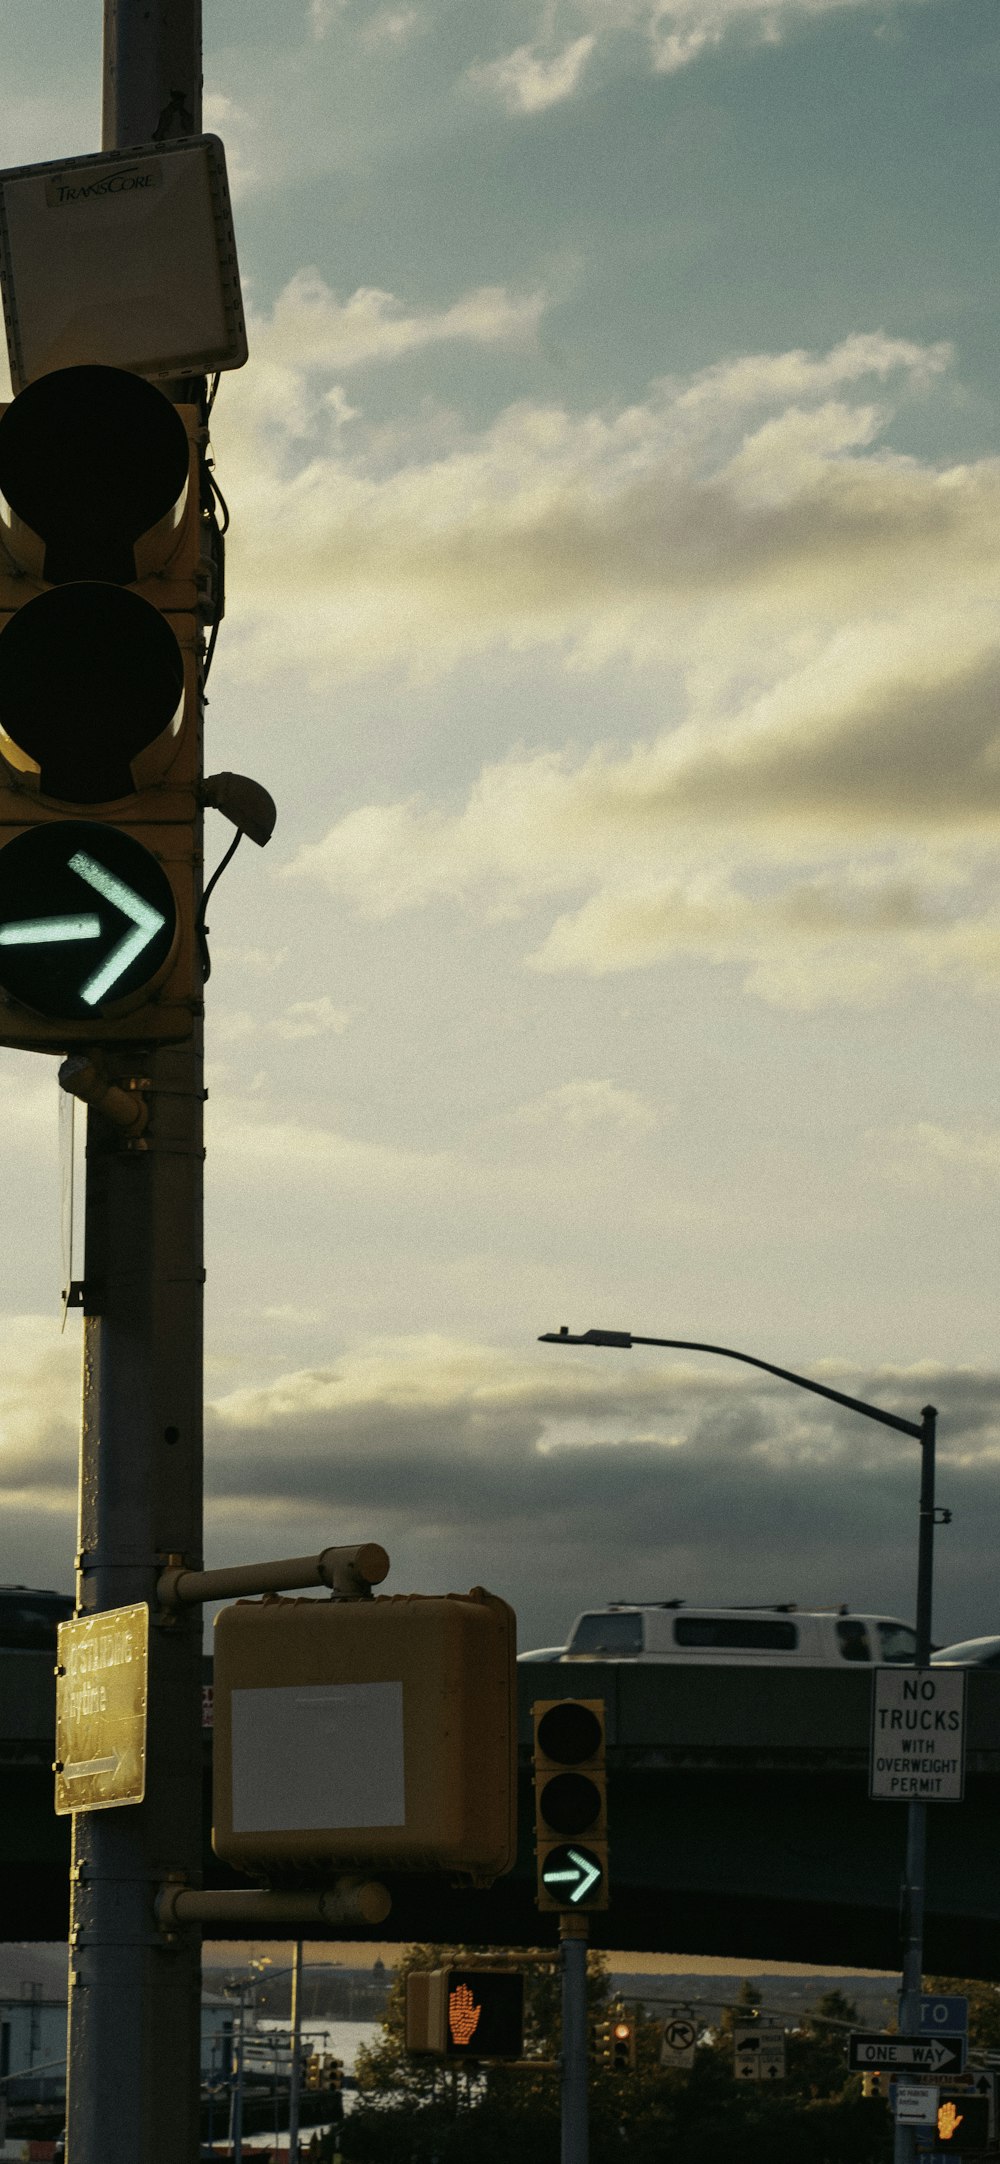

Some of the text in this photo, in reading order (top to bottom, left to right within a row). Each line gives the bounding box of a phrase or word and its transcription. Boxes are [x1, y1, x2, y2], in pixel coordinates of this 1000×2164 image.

[903, 1680, 936, 1700] NO
[878, 1709, 960, 1730] TRUCKS
[901, 1738, 935, 1753] WITH
[876, 1757, 958, 1773] OVERWEIGHT
[891, 1777, 942, 1792] PERMIT
[865, 2046, 946, 2063] ONE WAY
